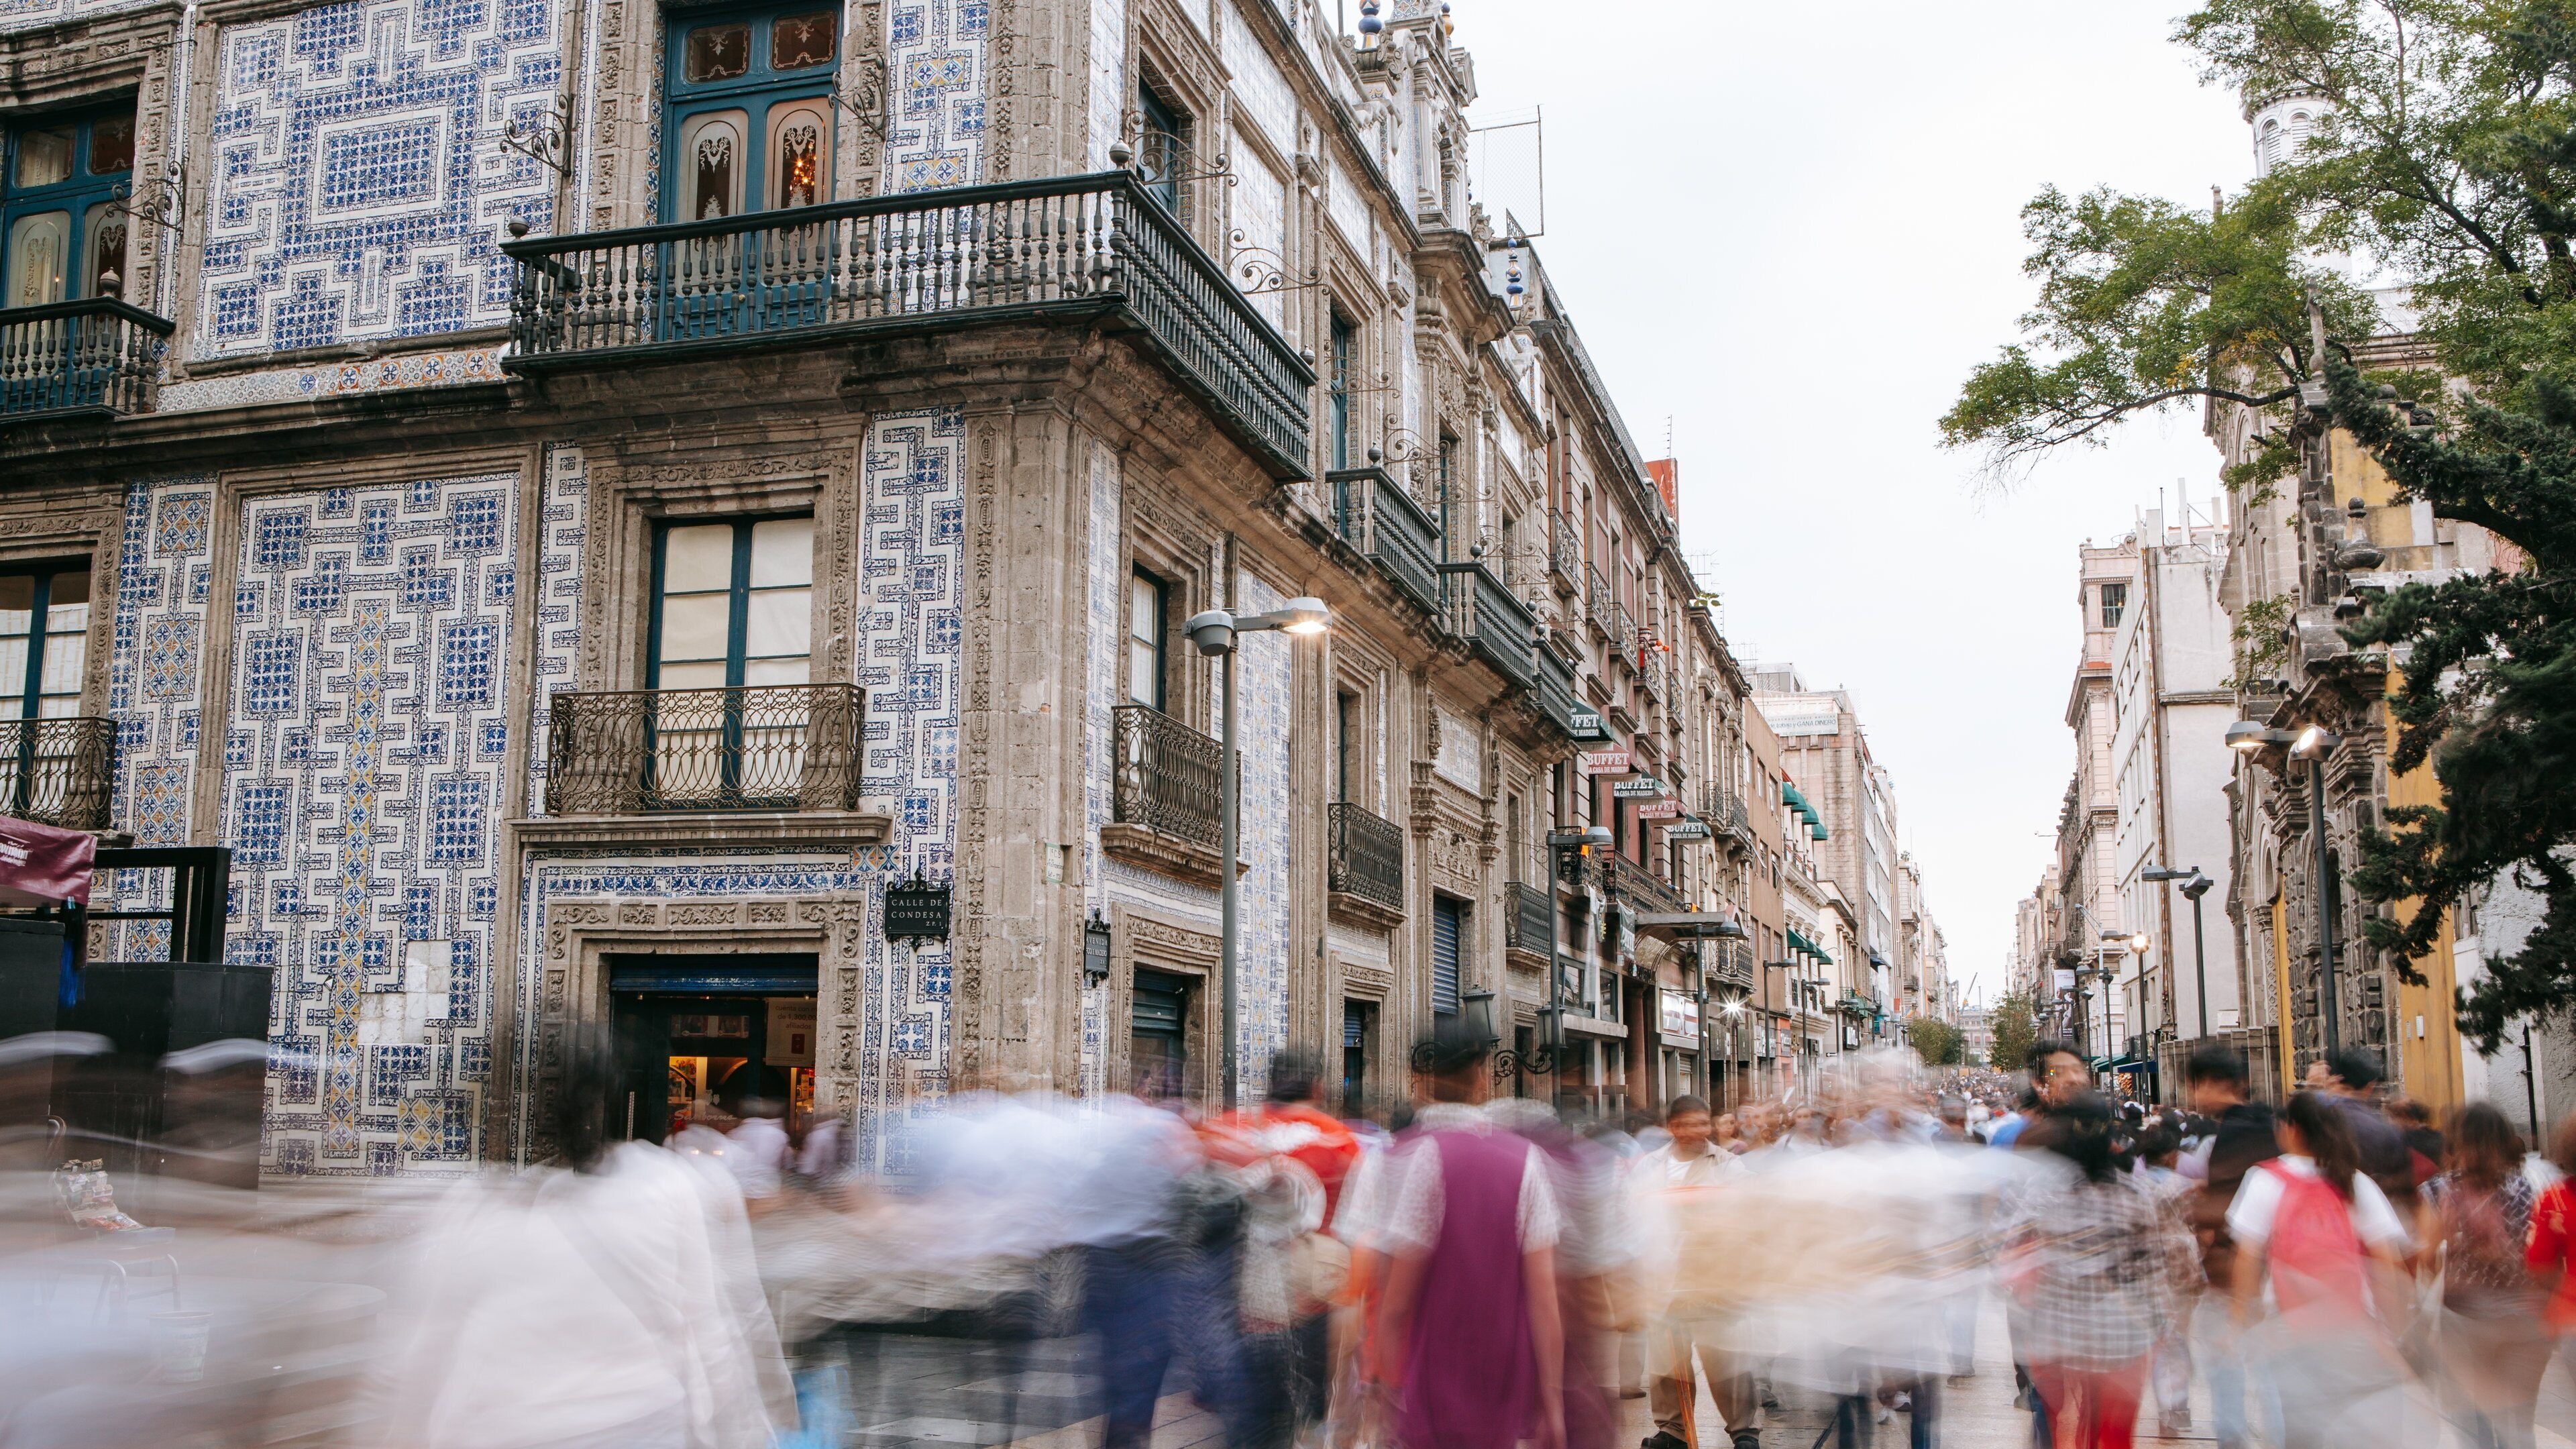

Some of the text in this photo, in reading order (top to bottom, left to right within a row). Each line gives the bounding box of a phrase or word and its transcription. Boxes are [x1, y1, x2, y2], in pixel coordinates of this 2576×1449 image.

[1588, 753, 1629, 765] BUFFET
[1614, 778, 1654, 790] BUFFET
[1670, 822, 1703, 832] BUFFET
[1087, 936, 1108, 946] AVENIDA
